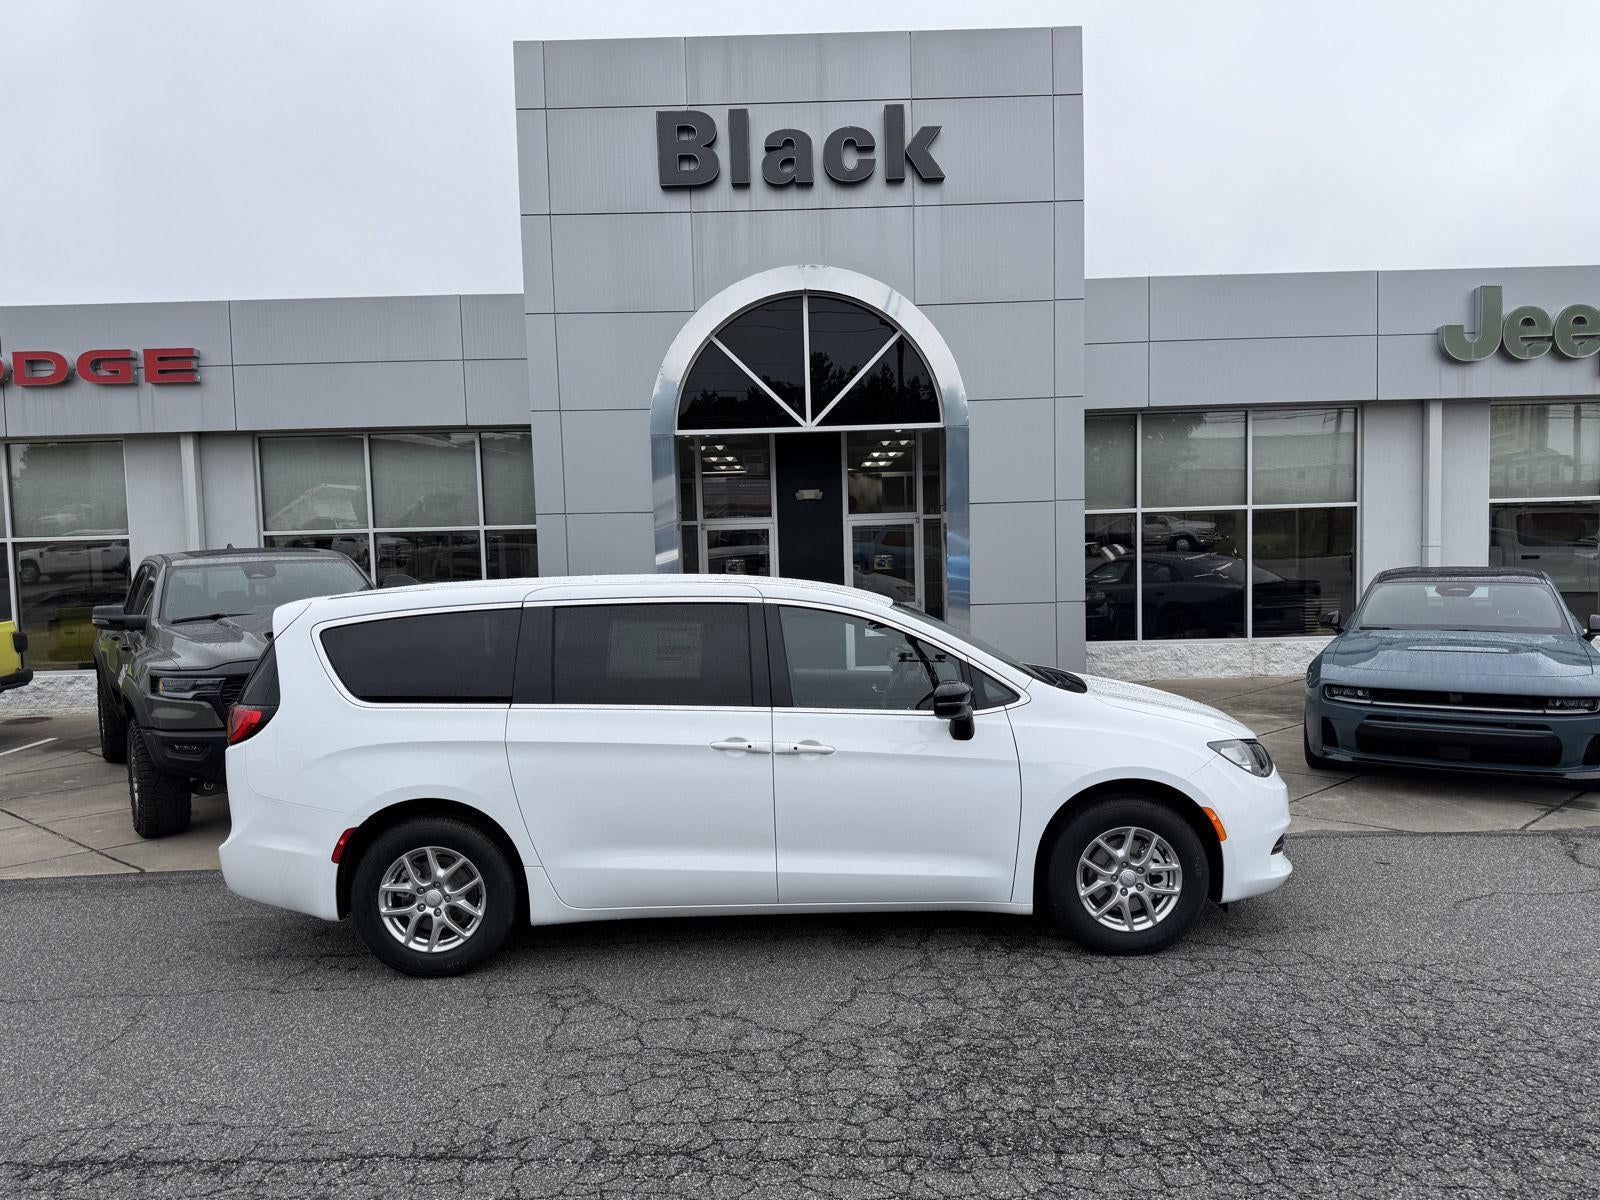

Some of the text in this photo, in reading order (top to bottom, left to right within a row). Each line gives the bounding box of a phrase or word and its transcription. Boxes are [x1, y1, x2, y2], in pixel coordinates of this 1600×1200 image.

[656, 103, 945, 188] Black
[1437, 285, 1600, 364] Jee
[0, 347, 200, 386] DGE
